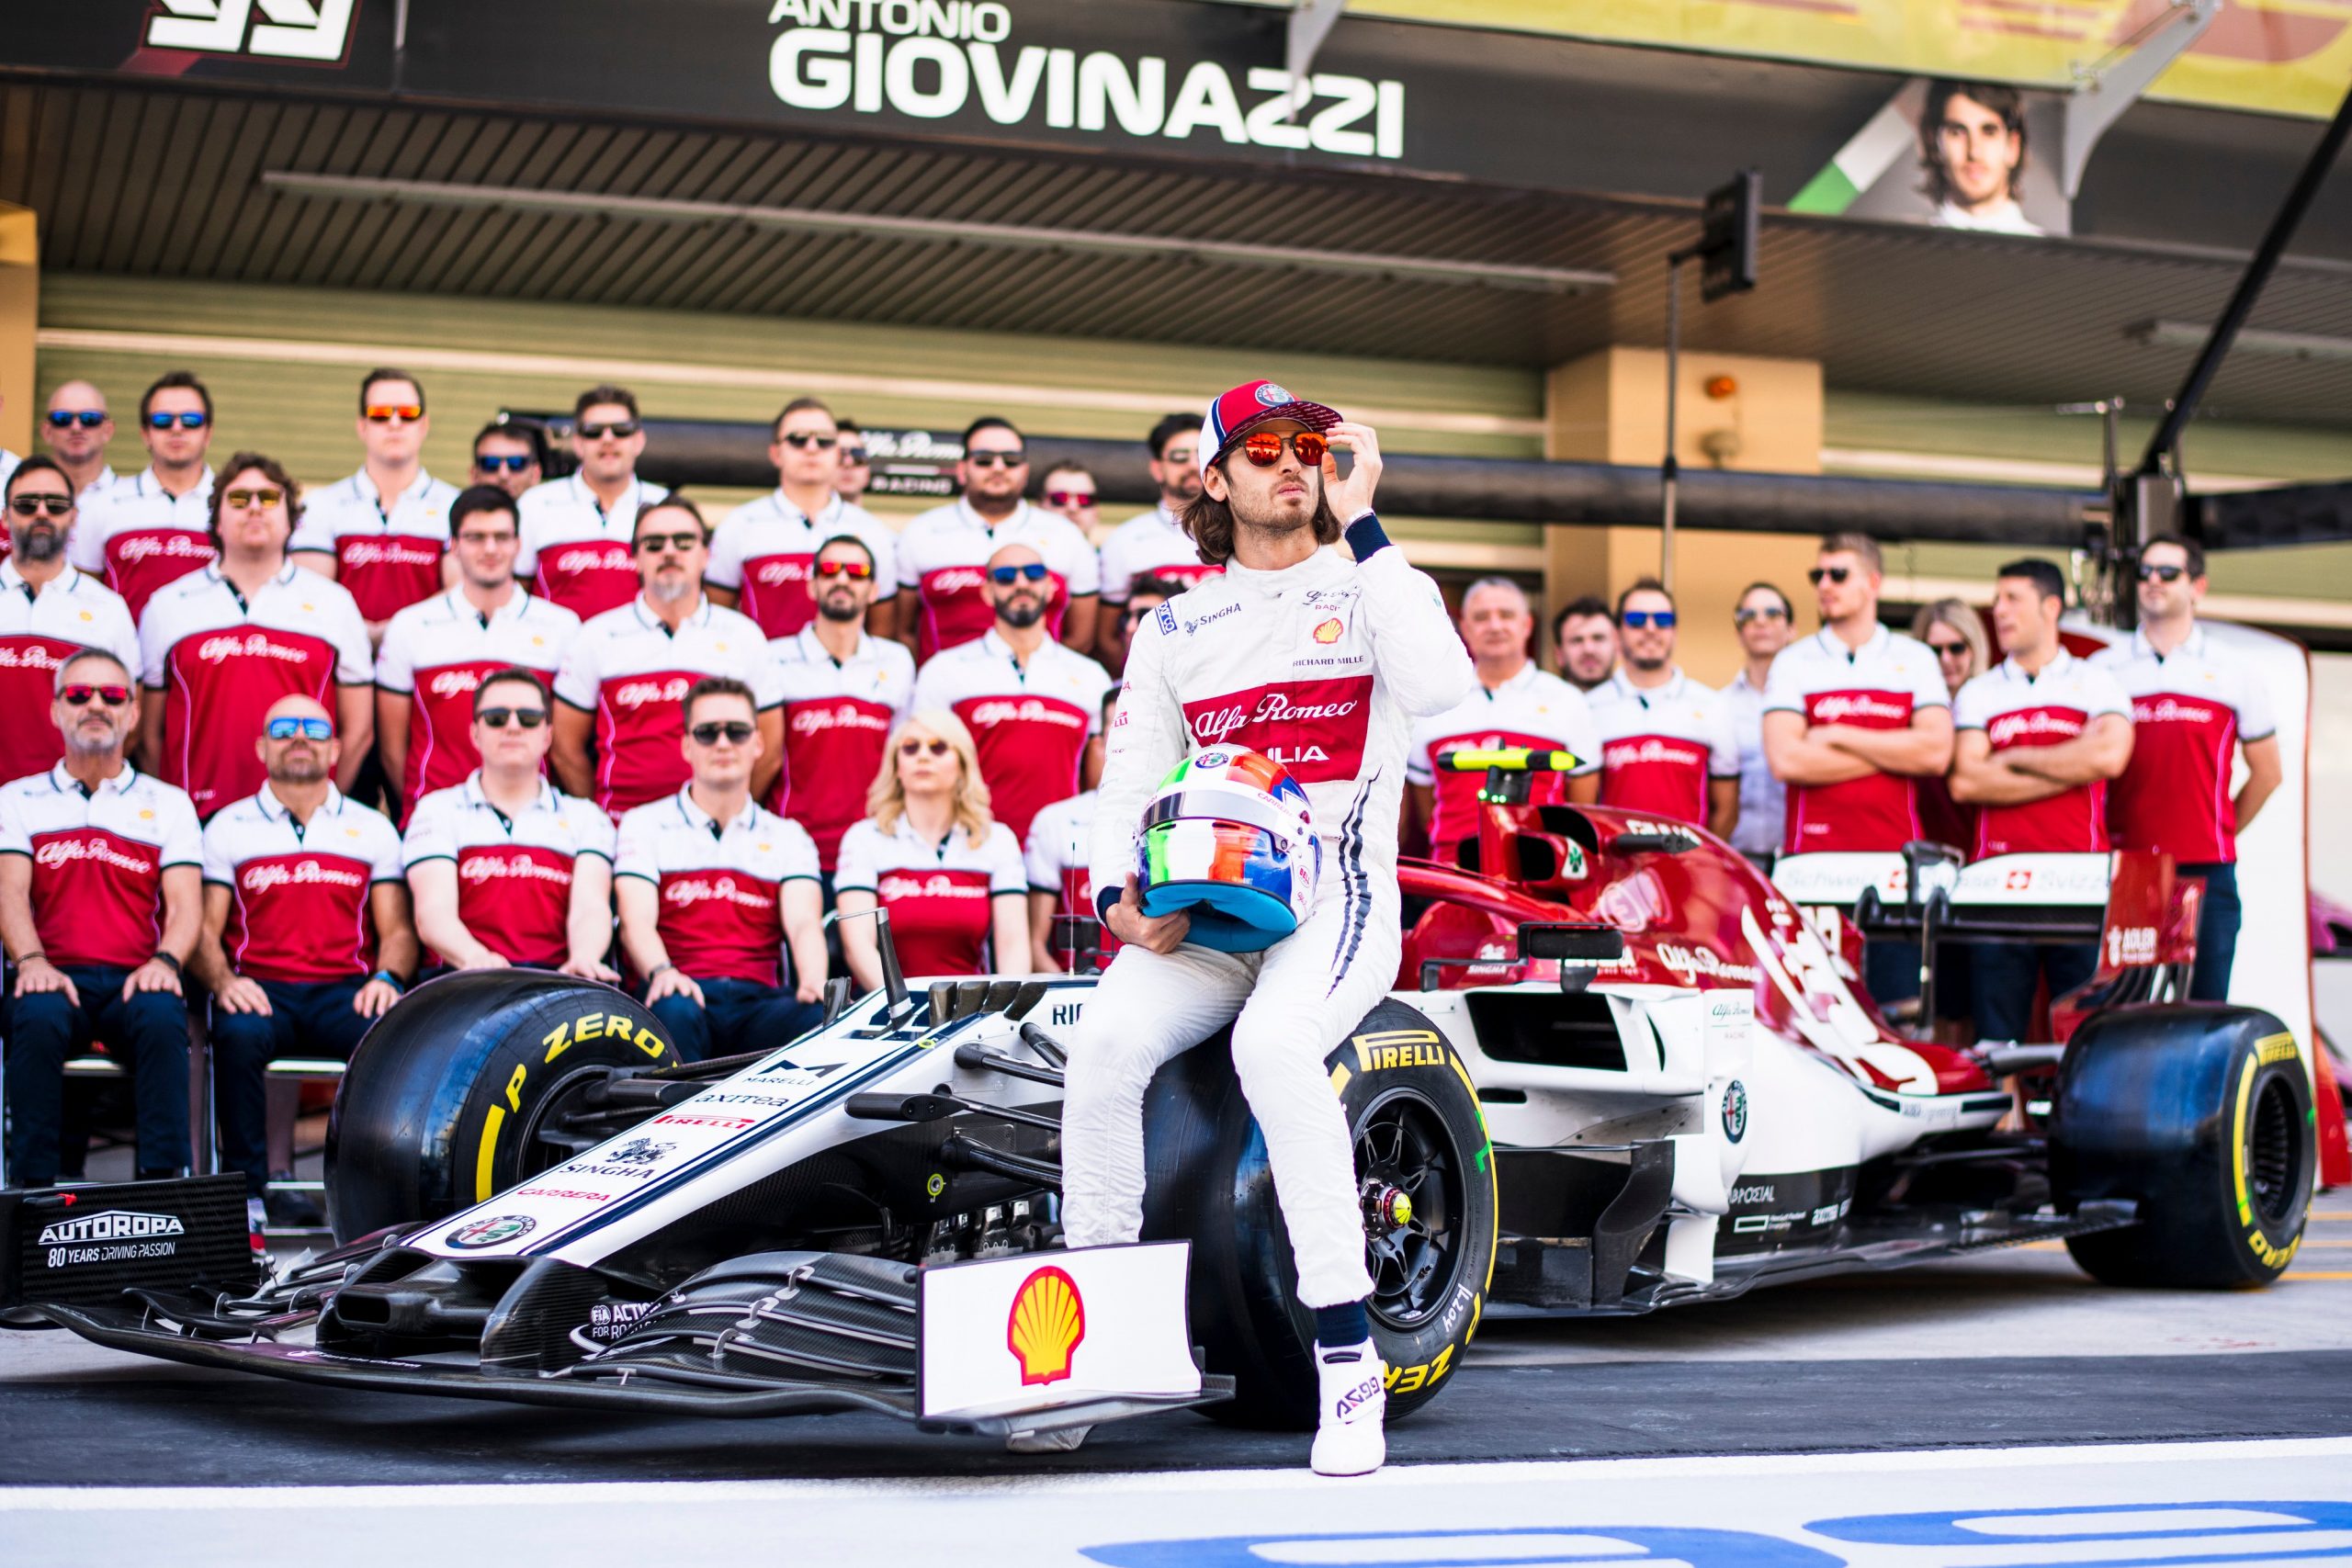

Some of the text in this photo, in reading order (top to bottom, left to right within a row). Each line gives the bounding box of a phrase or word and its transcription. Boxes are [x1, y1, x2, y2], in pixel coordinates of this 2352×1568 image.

[768, 0, 1012, 43] ANTONIO
[768, 28, 1405, 159] GIOVINAZZI
[1200, 603, 1242, 626] SINGHA
[244, 634, 309, 664] Romeo
[1293, 655, 1364, 667] RICHARD MILLE
[1194, 693, 1358, 744] Alfa Romeo
[36, 838, 152, 874] Alfa Romeo
[243, 860, 363, 895] Alfa Romeo
[1298, 867, 1312, 886] BELL
[504, 1011, 666, 1112] P ZERO
[1352, 1029, 1445, 1072] PIRELLI
[742, 1077, 816, 1087] MARELLI
[651, 1114, 755, 1129] PIRELLI
[559, 1163, 657, 1179] SINGHA
[517, 1188, 611, 1201] CARRERA
[38, 1214, 185, 1244] AUTOROPA
[47, 1242, 175, 1268] 80 YEARS DRIVING PASSION
[592, 1325, 610, 1337] FOR
[1384, 1343, 1454, 1394] ZER
